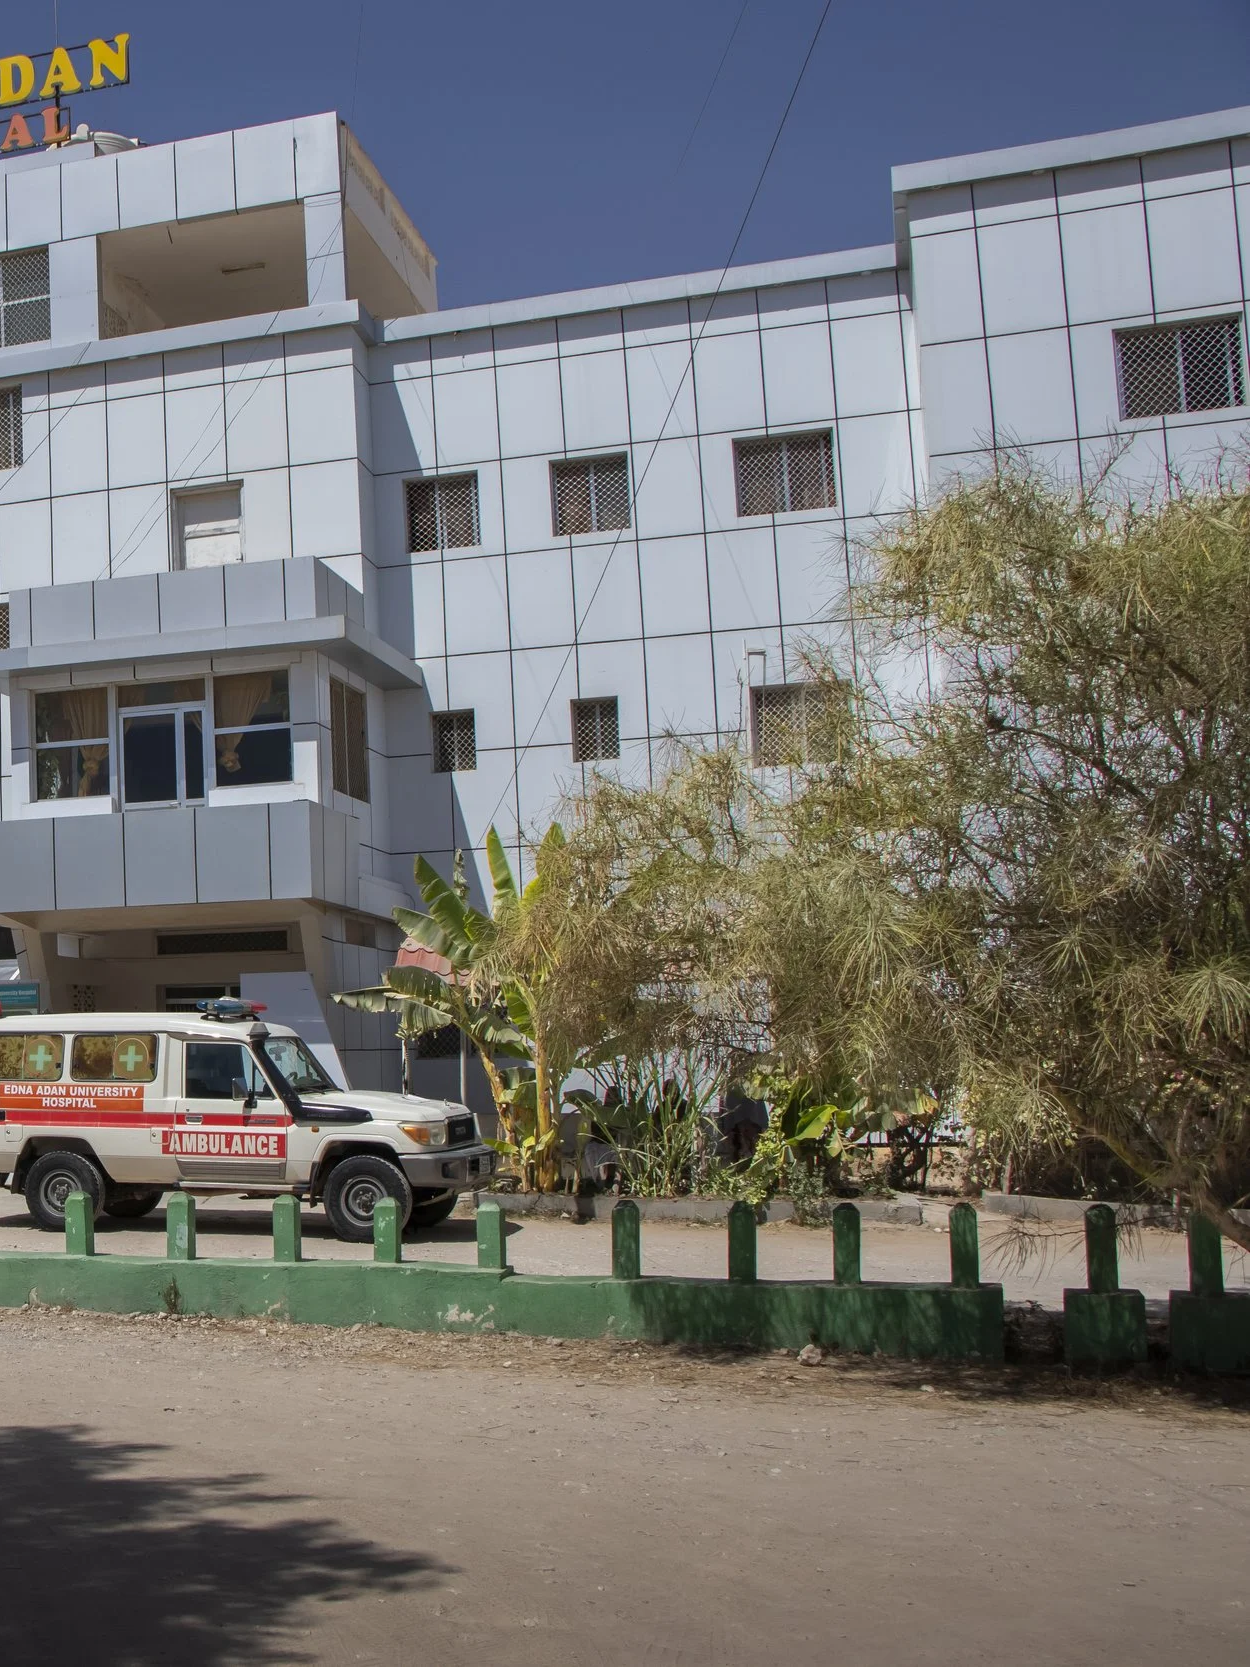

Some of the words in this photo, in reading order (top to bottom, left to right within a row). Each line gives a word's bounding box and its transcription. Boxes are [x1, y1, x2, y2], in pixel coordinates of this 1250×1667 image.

[3, 1084, 33, 1095] EDNA
[36, 1085, 66, 1096] ADAN
[69, 1086, 139, 1097] UNIVERSITY
[42, 1097, 97, 1108] HOSPITAL
[169, 1132, 279, 1156] AMBULANCE
